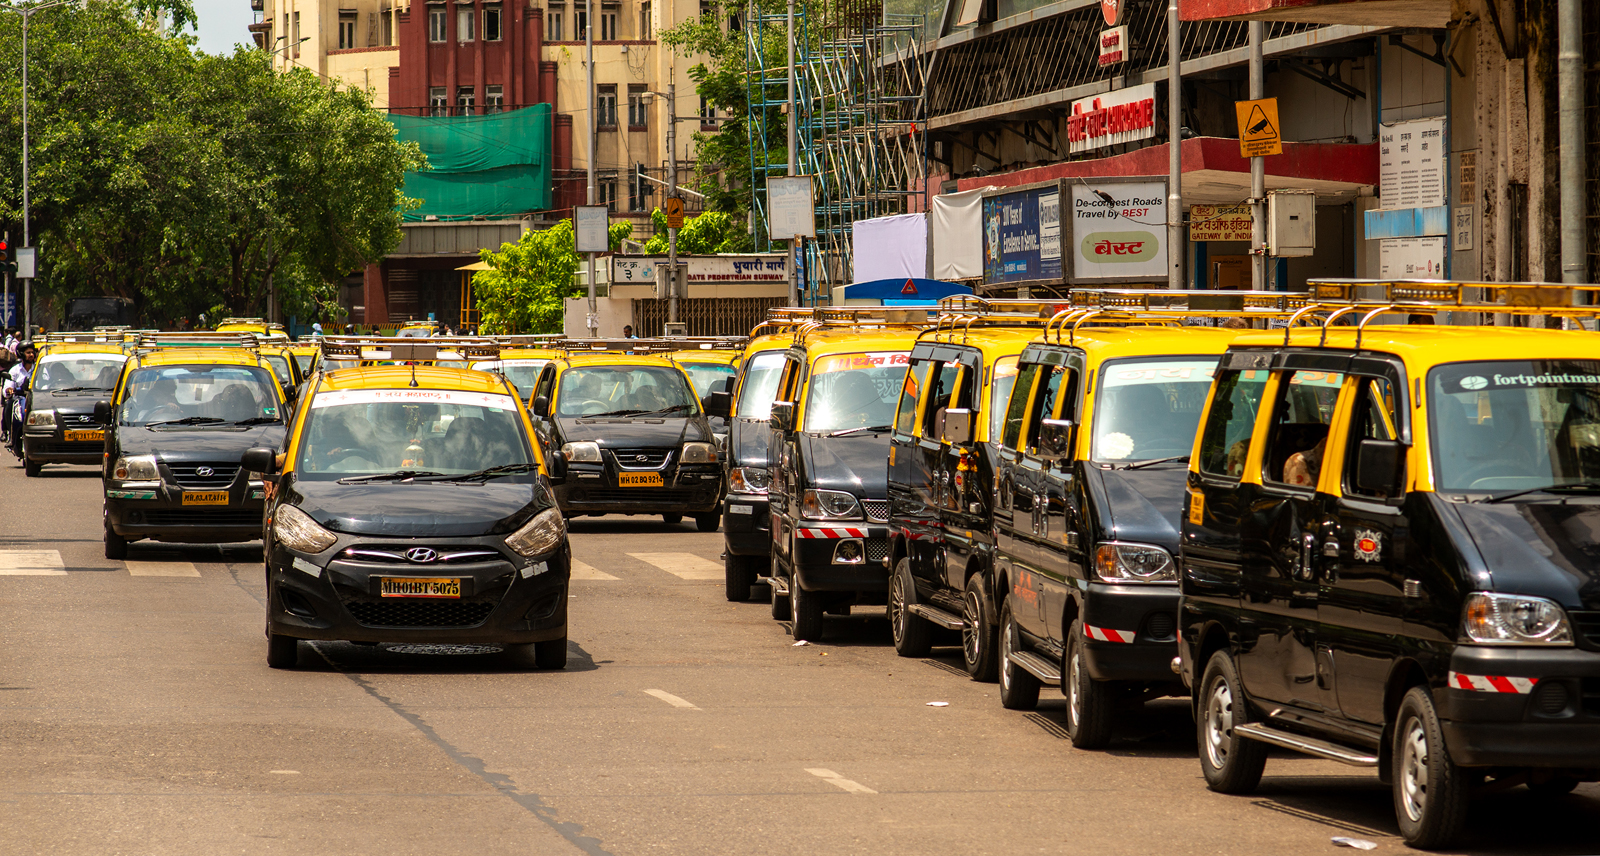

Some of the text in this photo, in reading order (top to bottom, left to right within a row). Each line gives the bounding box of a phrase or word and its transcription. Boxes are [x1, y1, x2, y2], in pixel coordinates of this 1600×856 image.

[1132, 197, 1162, 206] Roads
[1077, 208, 1149, 219] Travel by BEST
[1004, 232, 1021, 254] Excellence
[1094, 240, 1145, 255] बेस्ट
[616, 260, 628, 269] गेट
[733, 258, 786, 273] भुयारी मार्ग
[625, 269, 633, 281] ३
